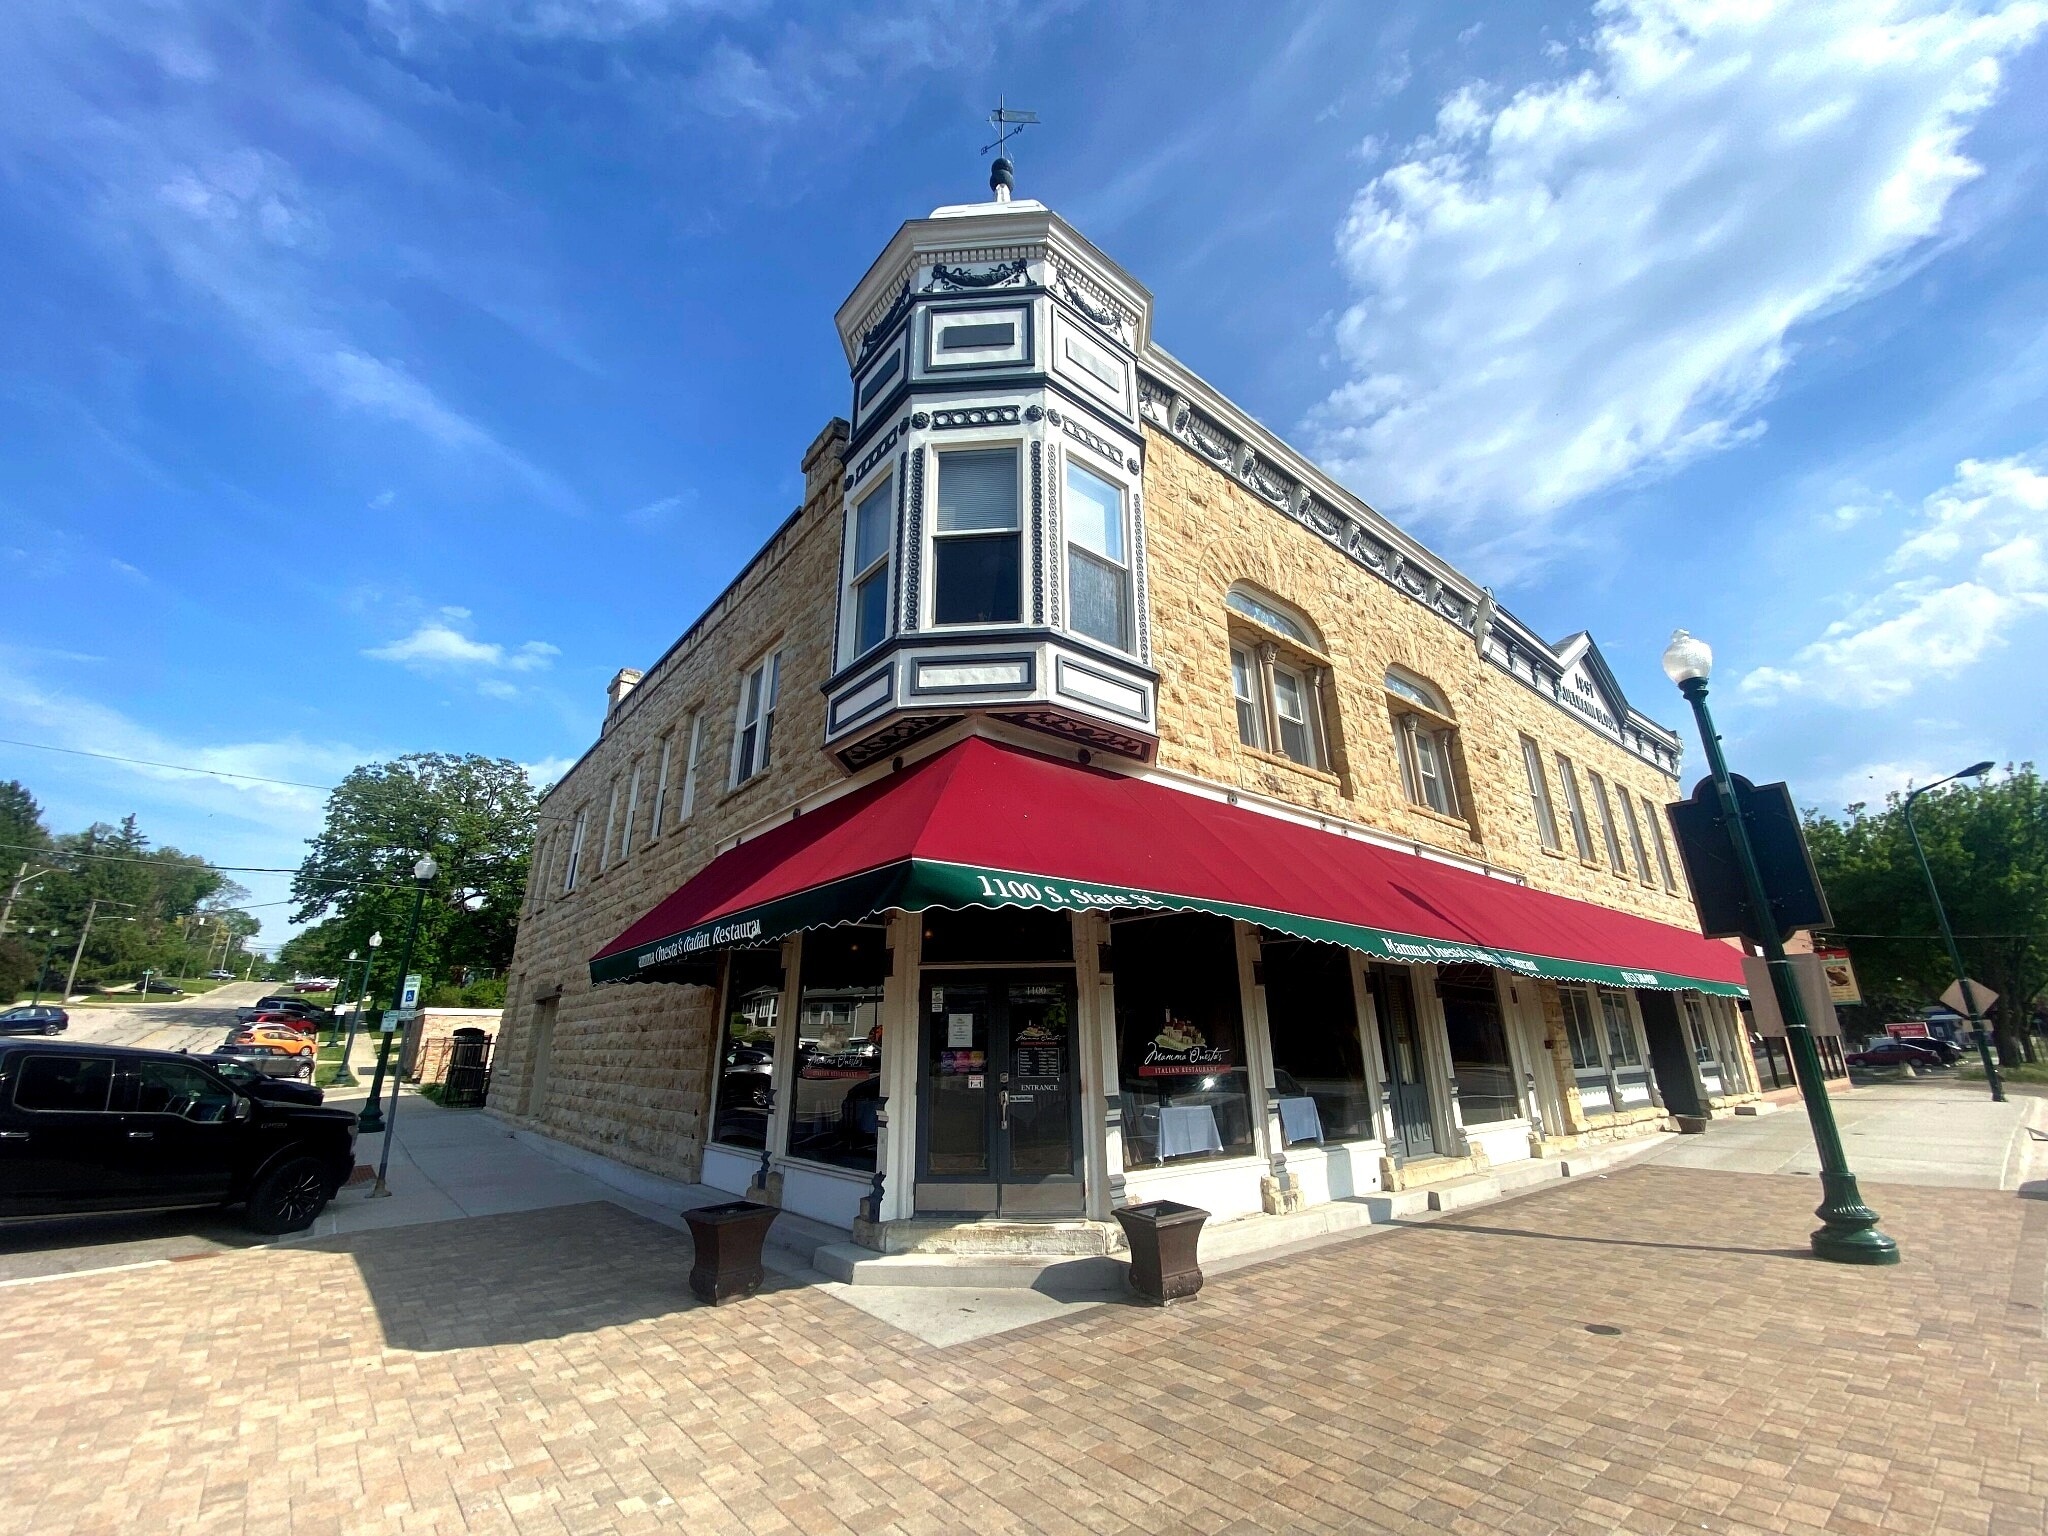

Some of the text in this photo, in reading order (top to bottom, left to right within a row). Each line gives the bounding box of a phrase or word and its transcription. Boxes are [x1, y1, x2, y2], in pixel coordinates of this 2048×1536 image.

[977, 876, 1163, 905] 1100 S. State St.
[656, 938, 683, 962] Onesta's
[683, 931, 710, 952] Italian
[713, 919, 761, 944] Restaura
[1381, 938, 1430, 957] Mamma
[1027, 987, 1046, 995] 1100
[1144, 1042, 1230, 1065] Mamma Onesta's
